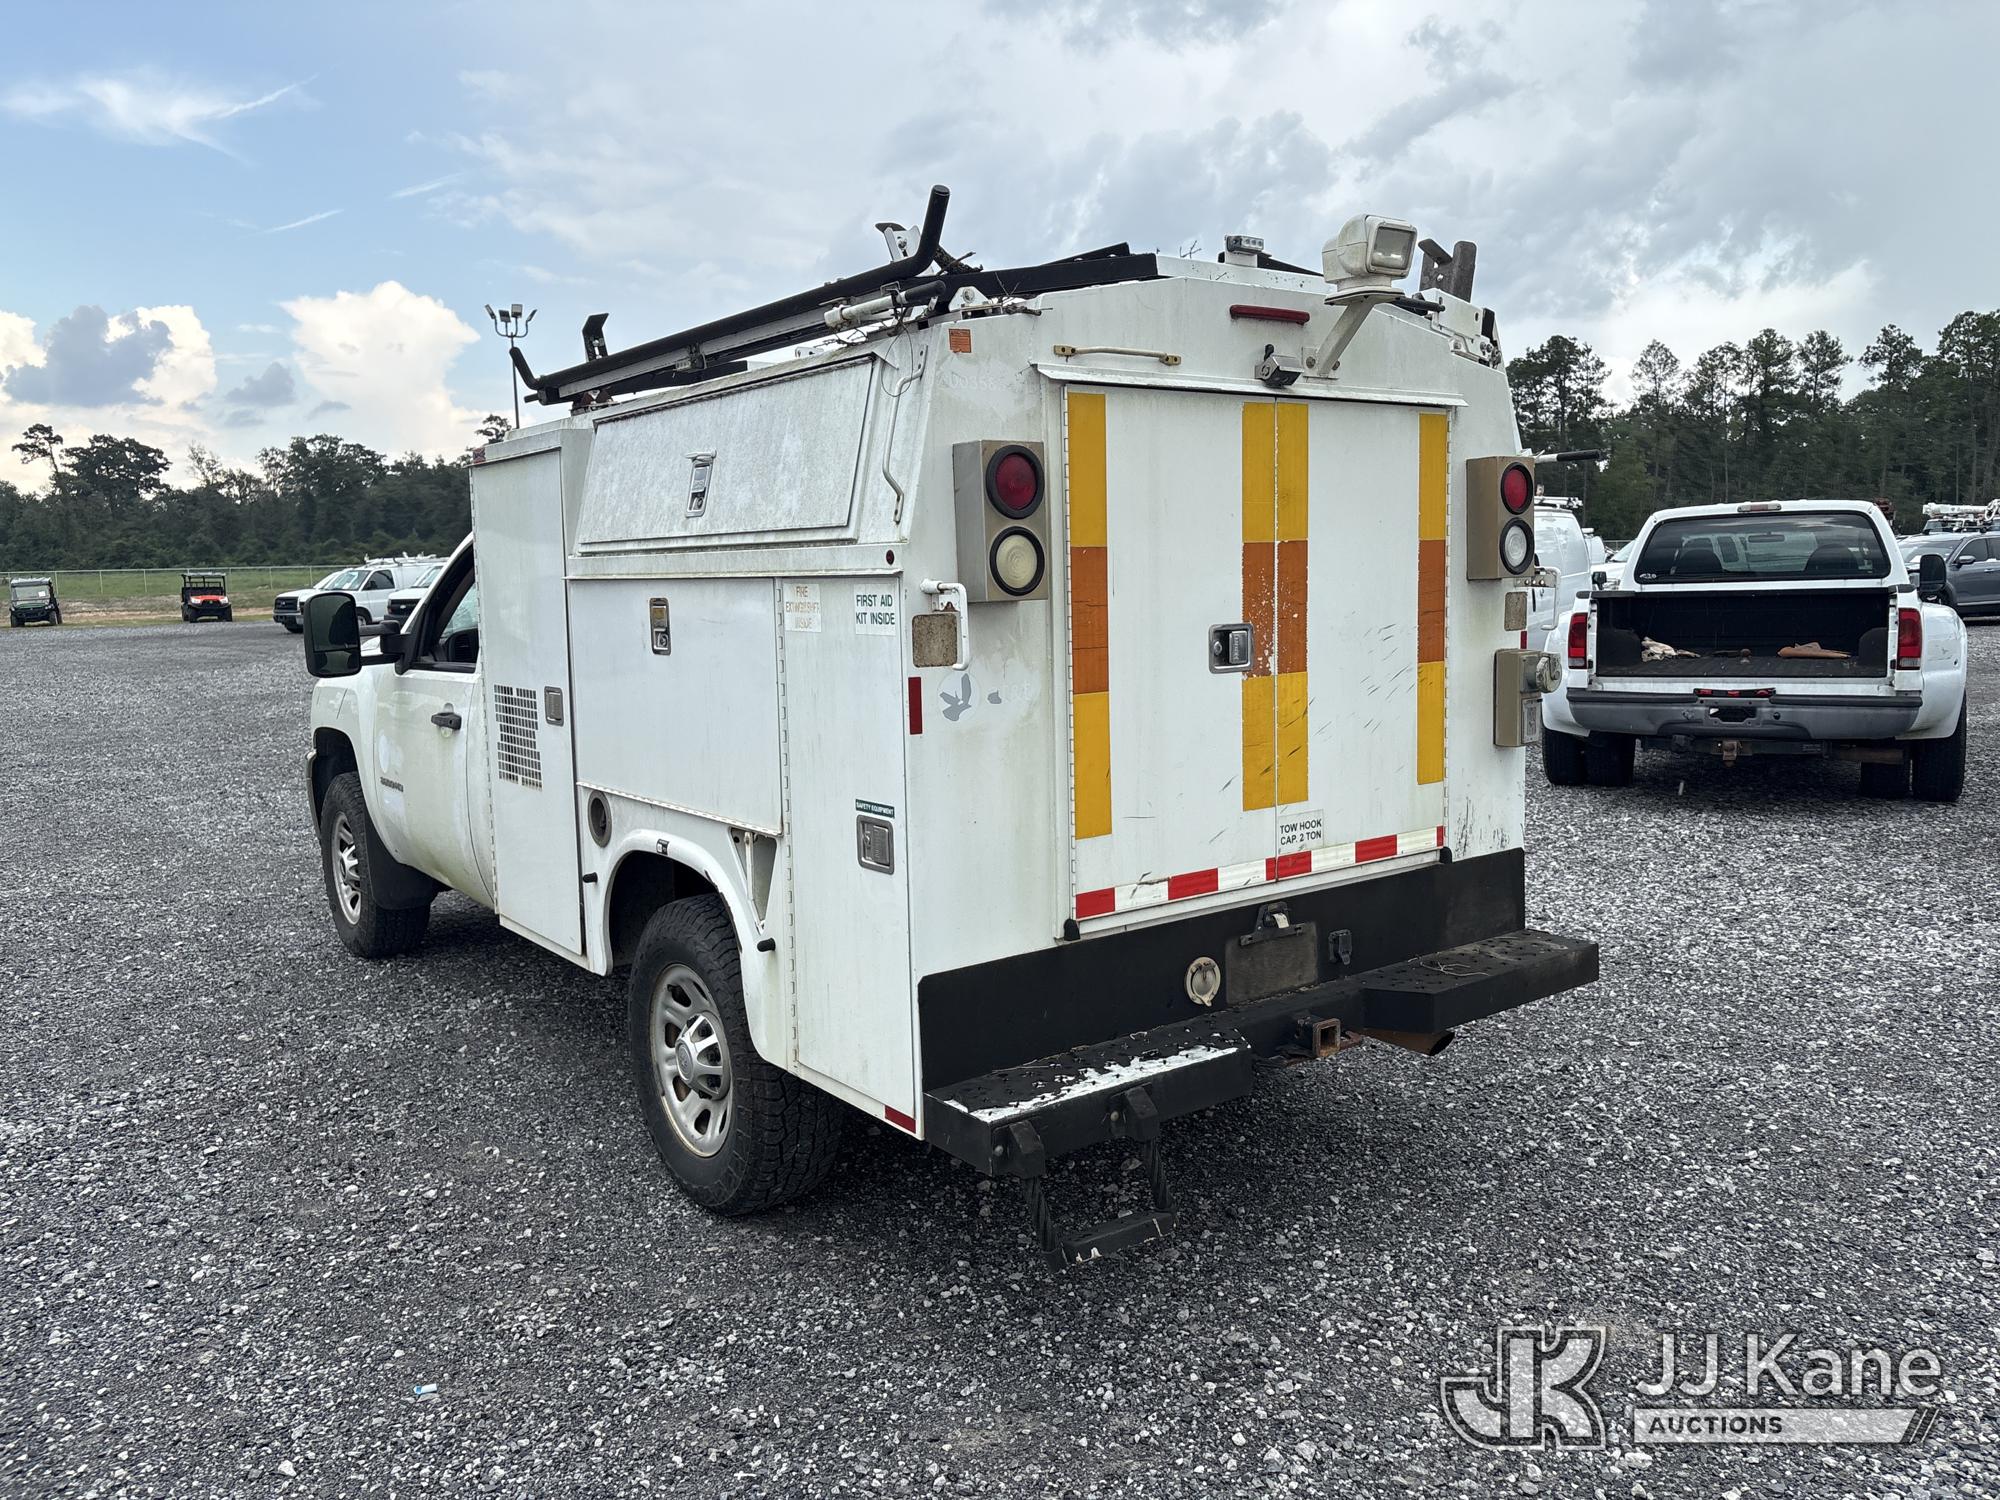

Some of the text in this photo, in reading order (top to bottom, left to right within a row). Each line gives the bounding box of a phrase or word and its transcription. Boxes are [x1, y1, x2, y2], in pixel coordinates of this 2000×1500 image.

[856, 594, 893, 607] FIRST AID
[855, 612, 895, 625] KIT INSIDE
[1280, 818, 1322, 834] TOW HOOK
[1280, 830, 1322, 845] CAP. 2 TON
